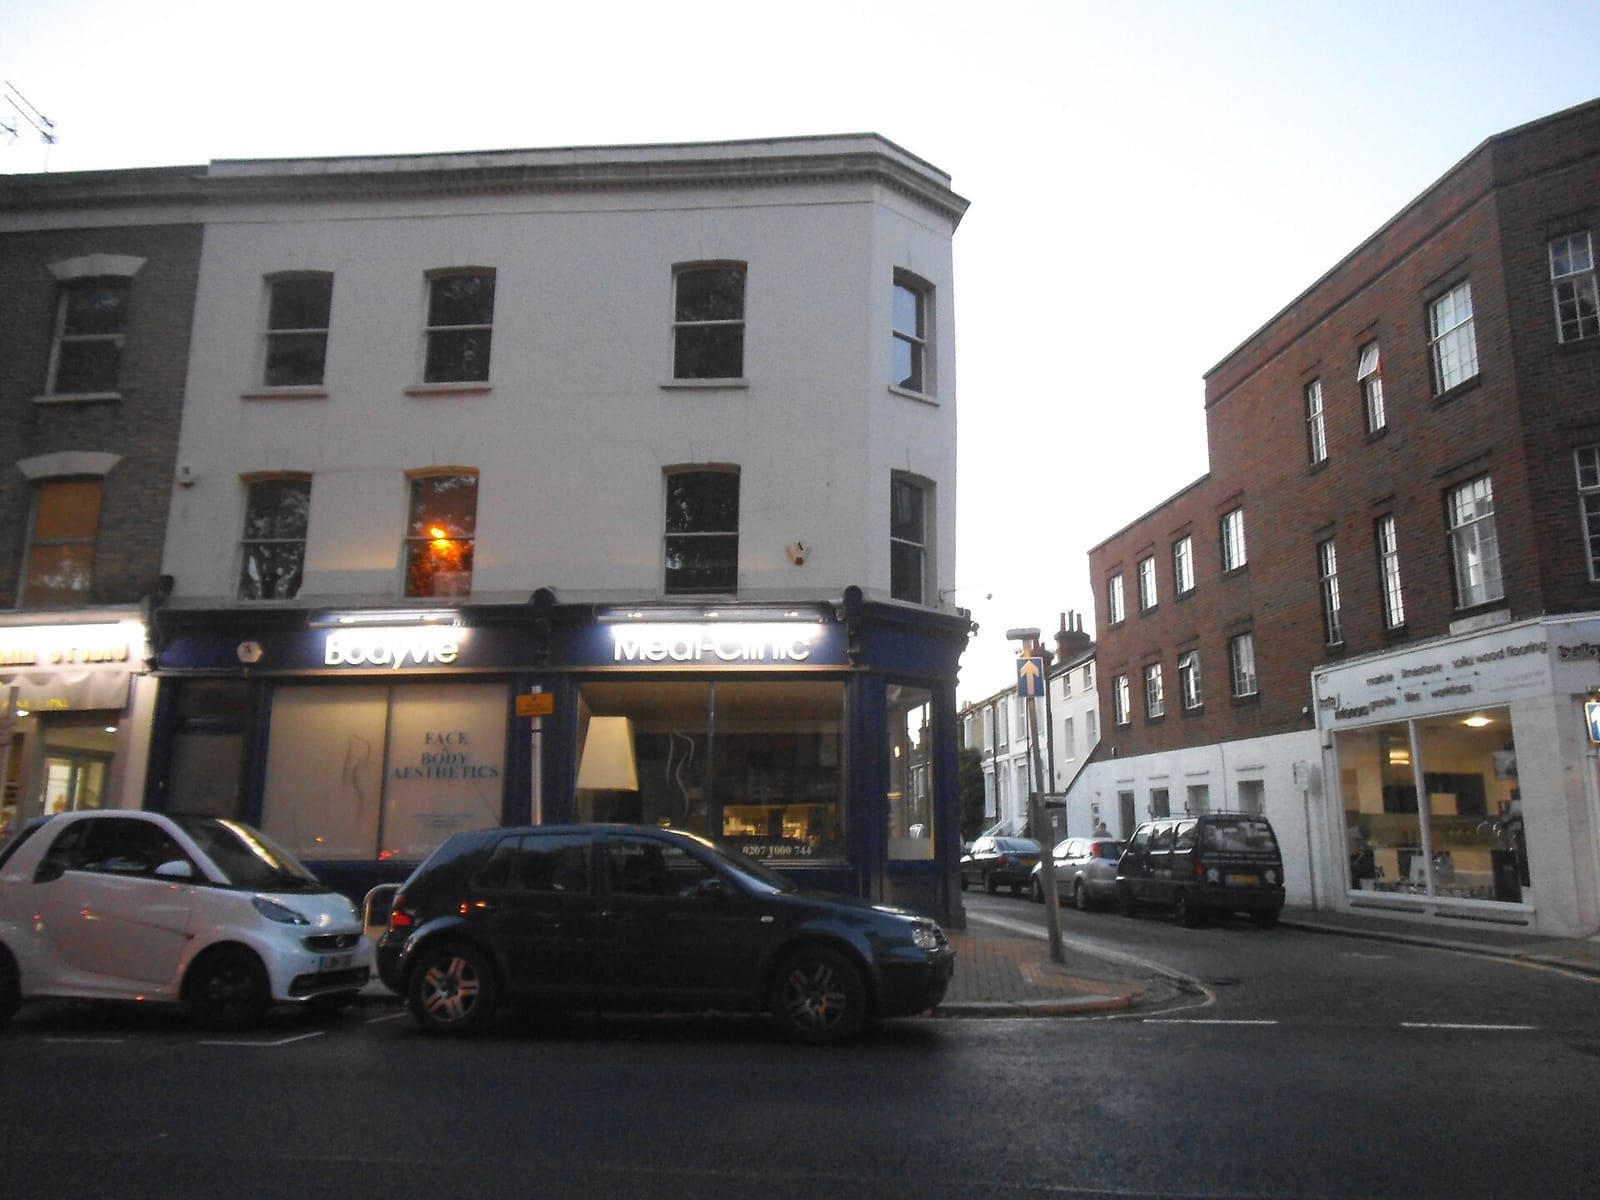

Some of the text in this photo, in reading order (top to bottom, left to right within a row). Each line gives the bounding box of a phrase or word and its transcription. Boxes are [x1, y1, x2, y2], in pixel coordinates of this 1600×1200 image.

[424, 732, 469, 745] FACE
[421, 752, 469, 766] BODY
[391, 765, 500, 779] AESTHETICS
[742, 845, 766, 856] 0207
[794, 845, 812, 856] 744
